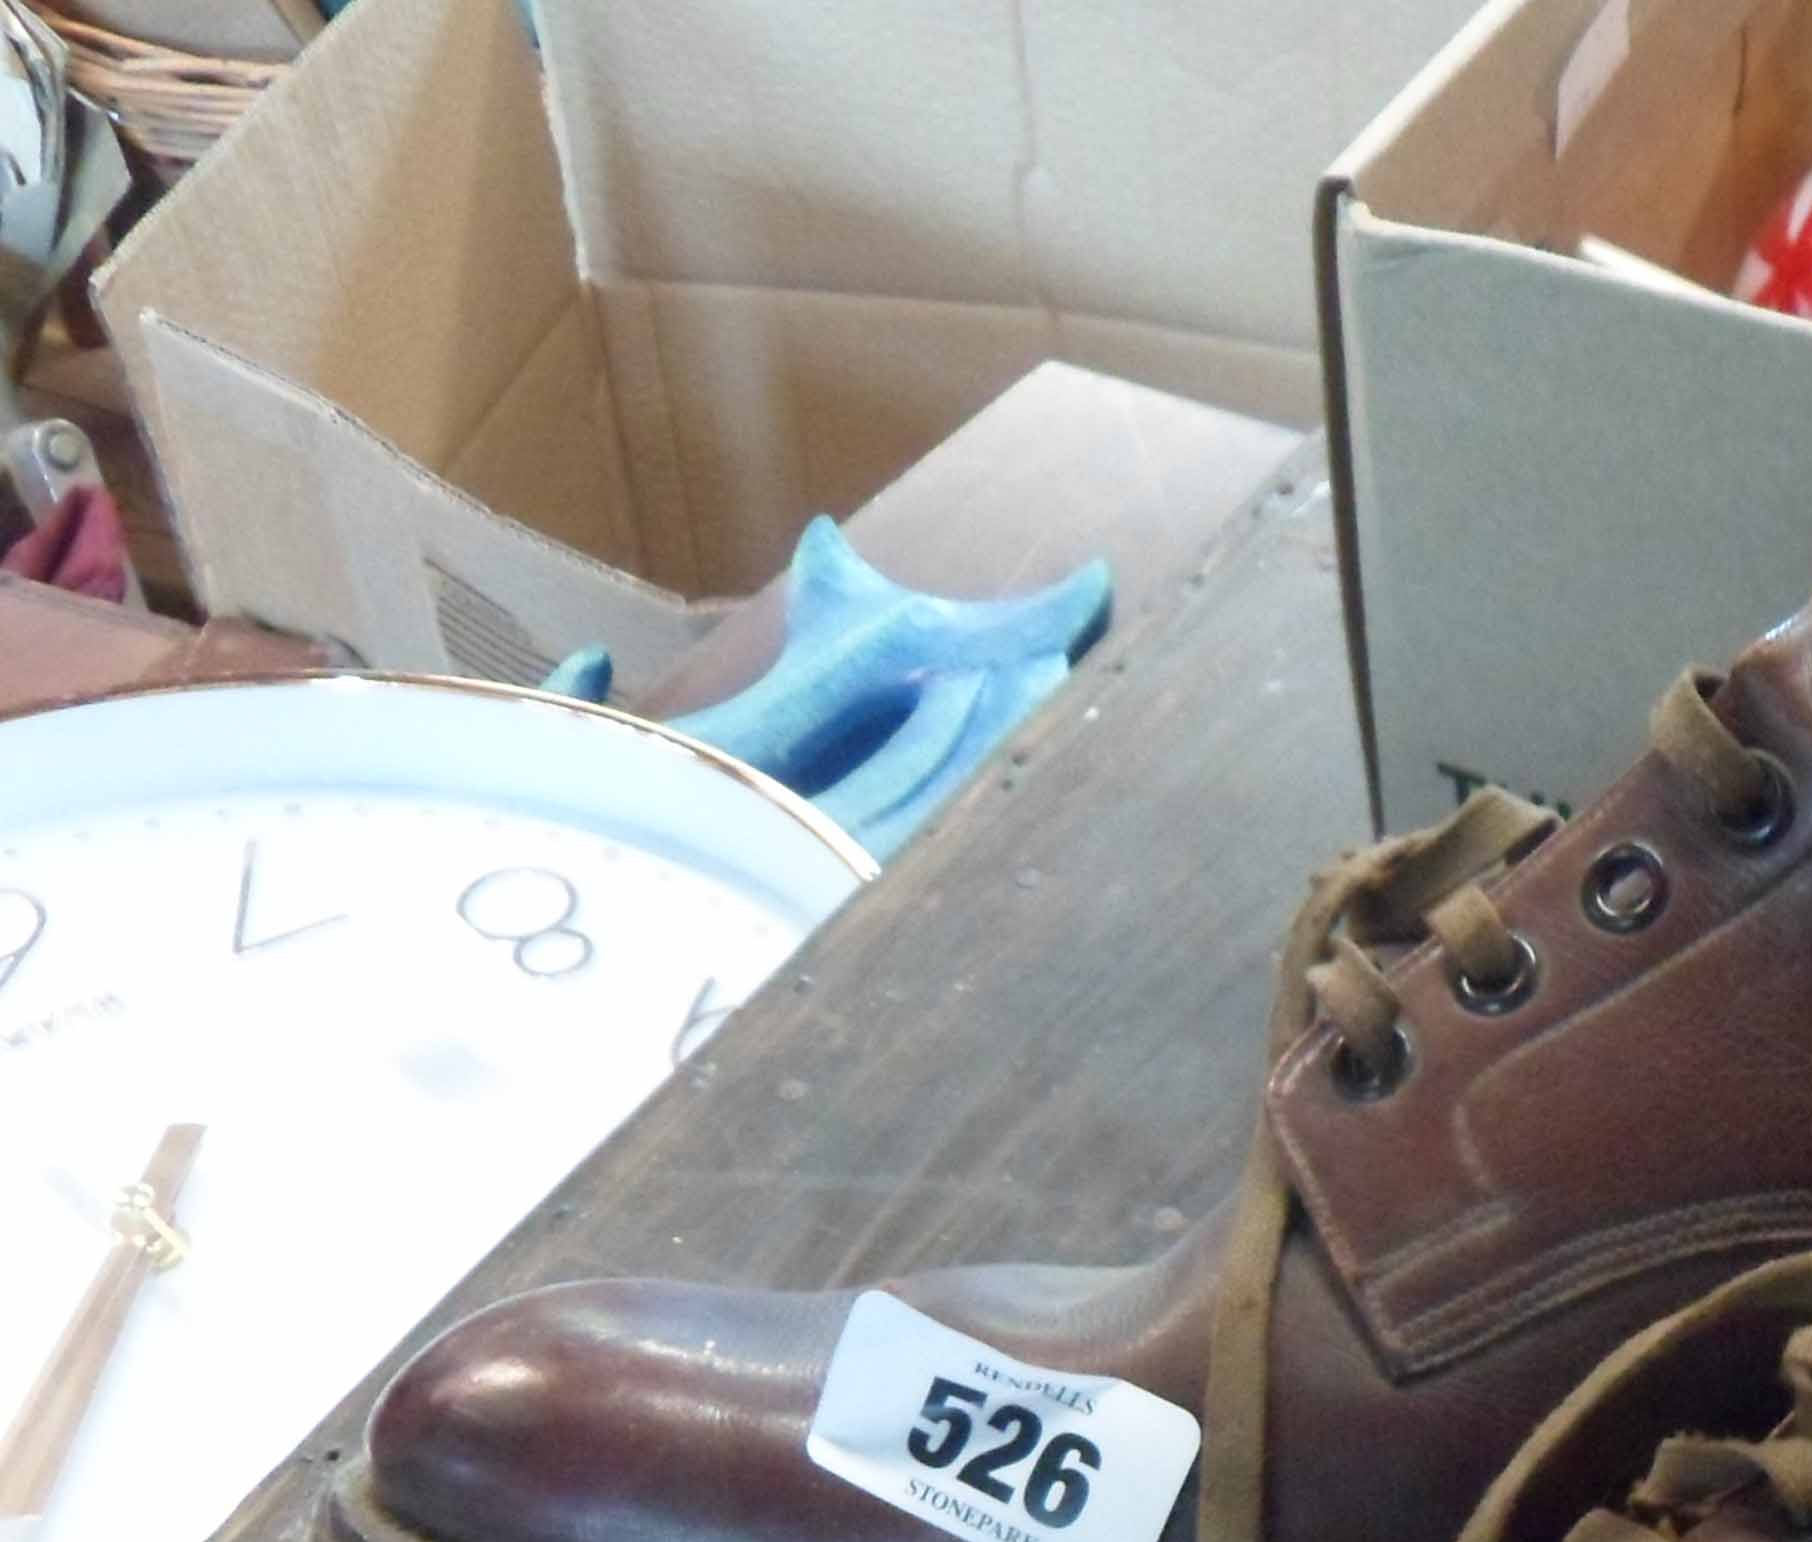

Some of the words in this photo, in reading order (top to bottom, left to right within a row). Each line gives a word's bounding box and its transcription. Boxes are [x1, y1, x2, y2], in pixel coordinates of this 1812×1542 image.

[456, 867, 592, 977] 8
[975, 1362, 1094, 1415] RENDELLS
[908, 1376, 1101, 1528] 526
